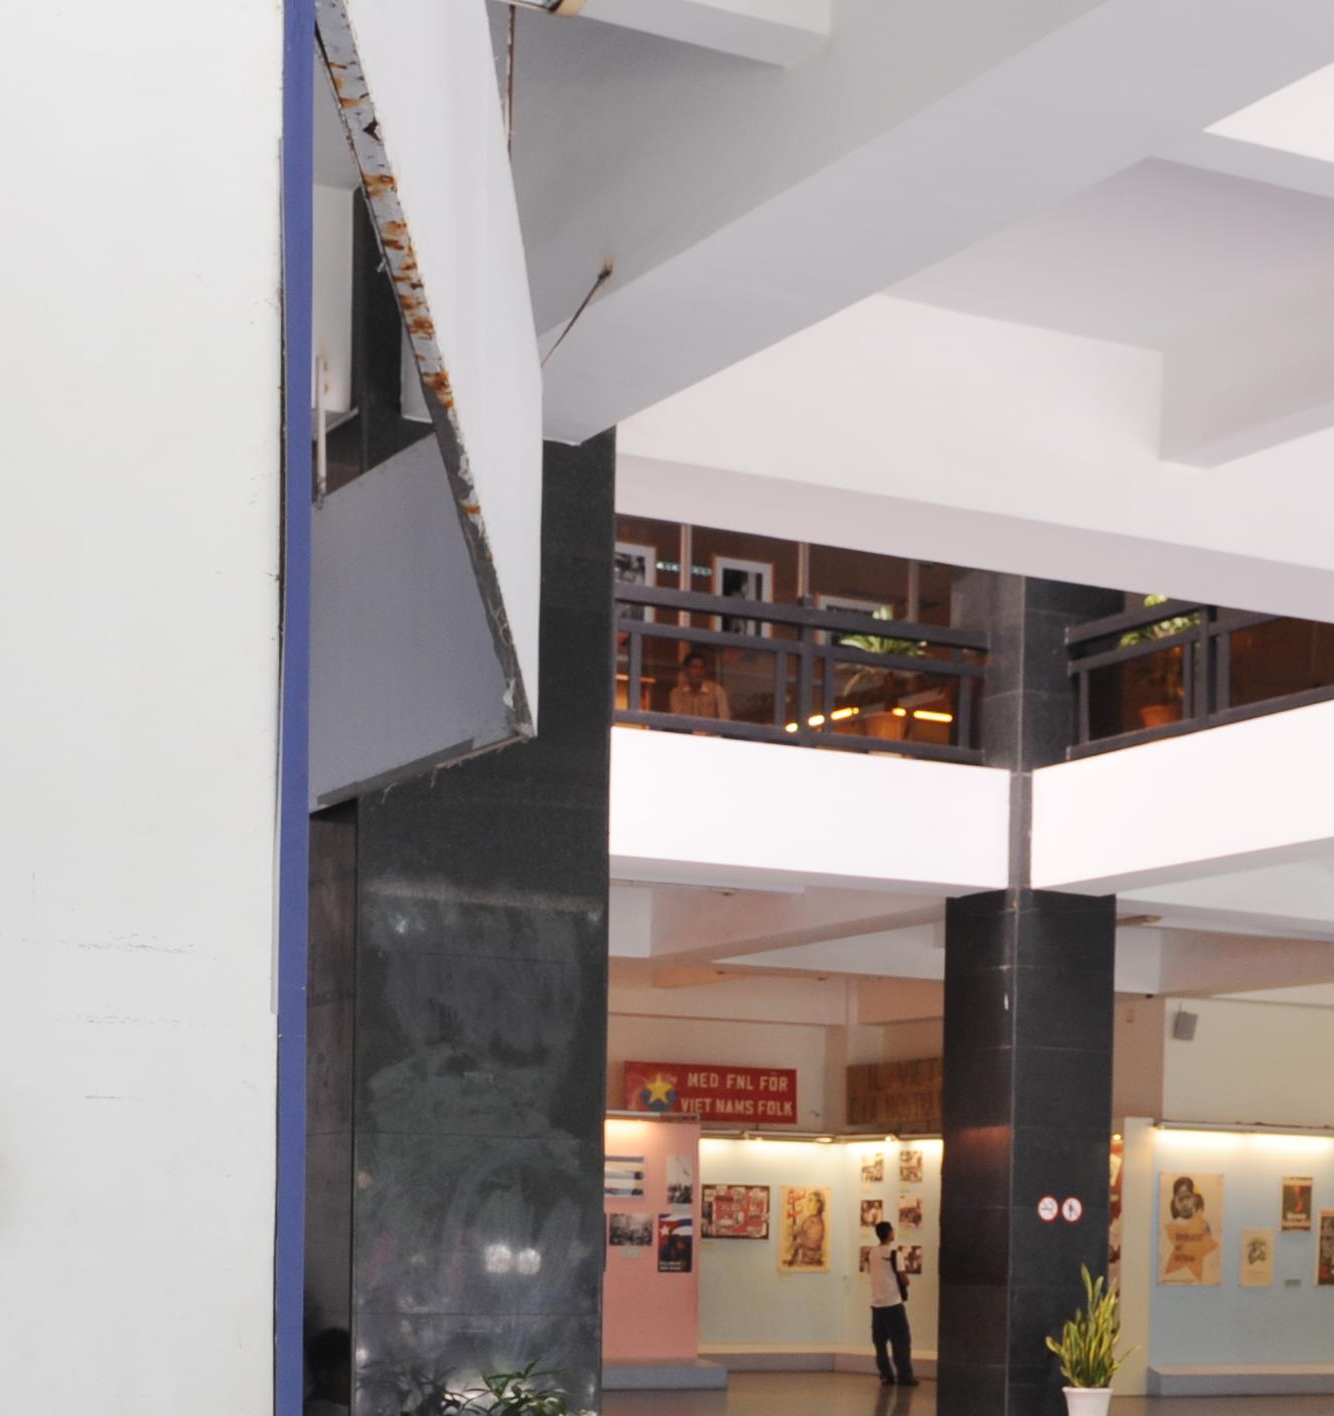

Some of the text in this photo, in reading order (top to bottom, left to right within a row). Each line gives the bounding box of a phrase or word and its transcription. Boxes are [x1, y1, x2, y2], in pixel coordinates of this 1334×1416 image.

[687, 1072, 719, 1088] MED
[727, 1074, 754, 1090] FNL
[680, 1097, 793, 1116] VIET NAMS FOLK
